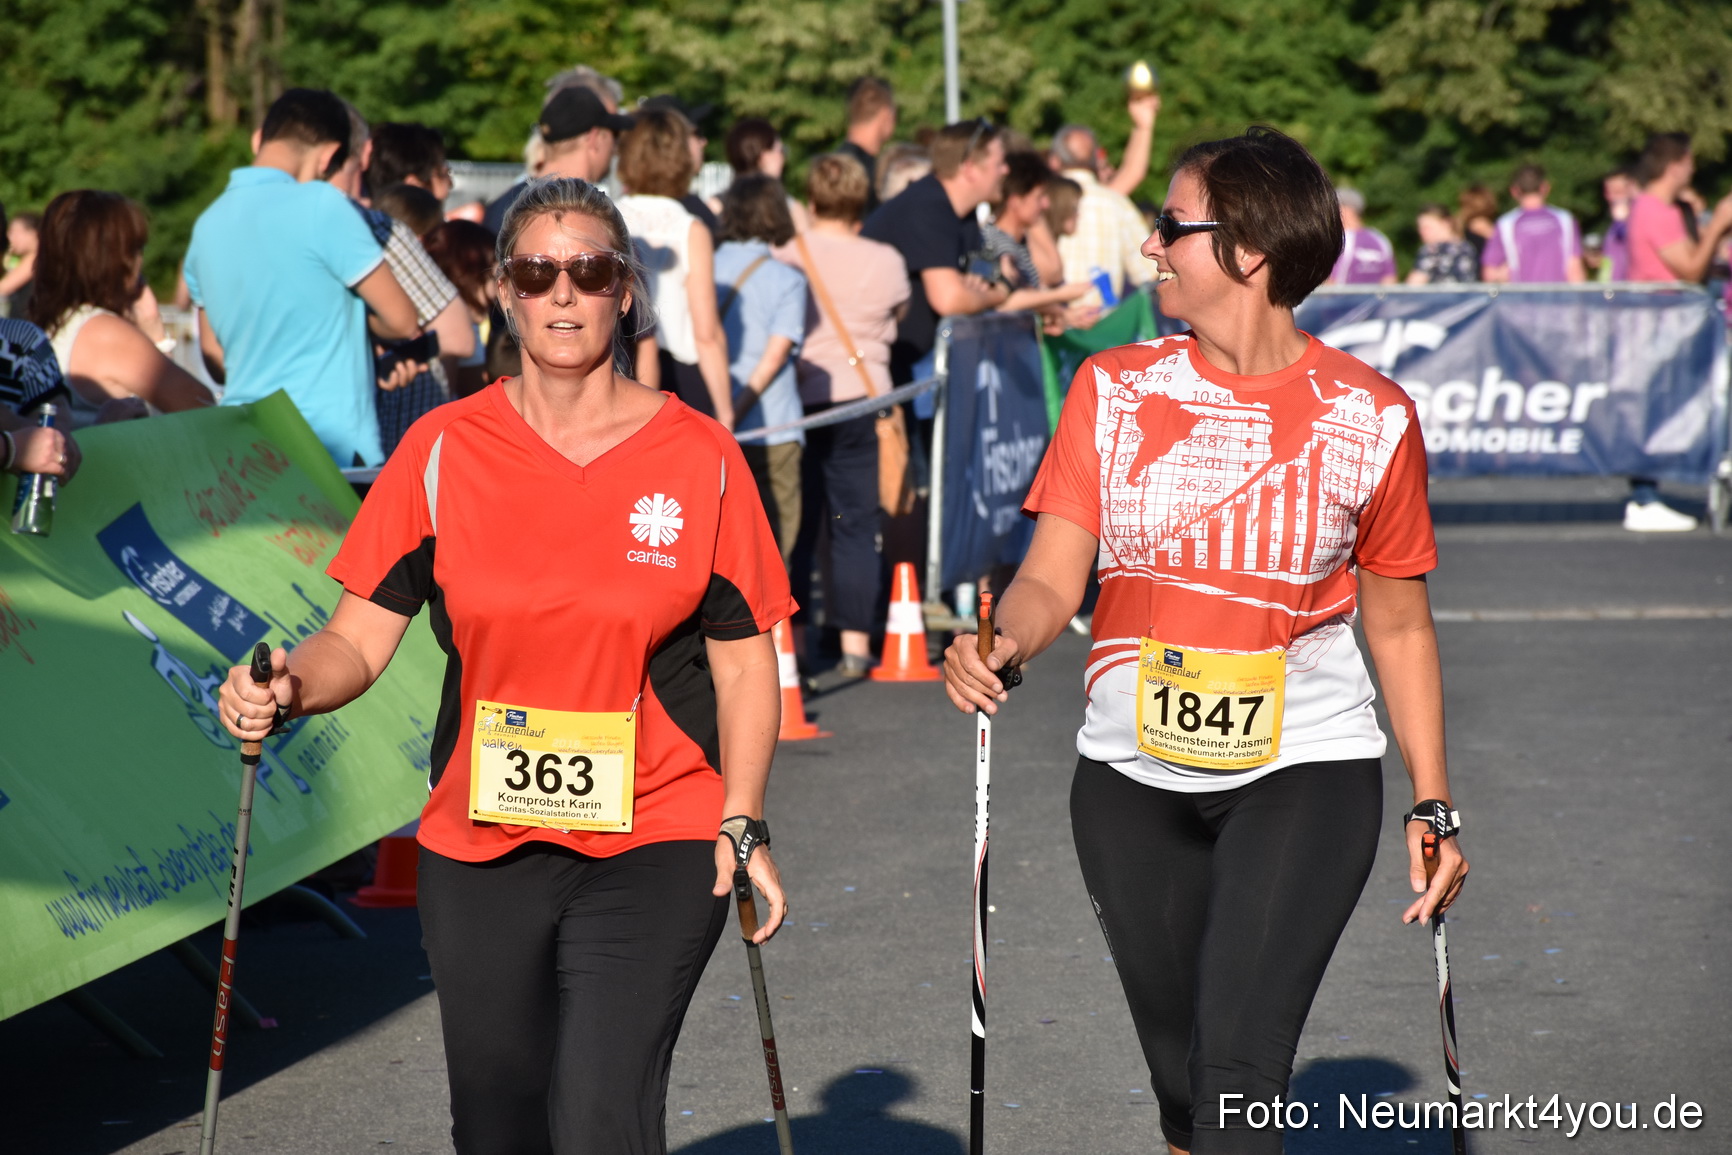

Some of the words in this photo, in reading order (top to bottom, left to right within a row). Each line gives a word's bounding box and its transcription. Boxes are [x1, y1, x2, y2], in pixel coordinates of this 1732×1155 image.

[1192, 390, 1231, 405] 10.54
[1406, 366, 1608, 423] scher
[1330, 407, 1381, 430] 91.62%
[1183, 434, 1228, 448] 24.87
[1425, 427, 1584, 454] OMOBILE
[1180, 455, 1224, 470] 52.01
[1176, 477, 1222, 493] 26.22
[626, 549, 677, 569] caritas
[1155, 660, 1201, 680] firmenlauf
[1153, 686, 1264, 736] 1847
[494, 721, 546, 738] firmenlauf
[1143, 723, 1230, 749] Kerschensteiner
[1233, 736, 1273, 749] Jasmin
[1150, 737, 1186, 753] Sparkasse
[1187, 747, 1262, 759] Neumarkt-Parsberg
[504, 749, 594, 797] 363
[498, 792, 565, 808] Kornprobst
[569, 798, 602, 810] Karin
[498, 804, 581, 818] Caritas-Sozialstation
[583, 811, 599, 819] e.V.
[1436, 802, 1446, 833] LEKI
[739, 833, 753, 860] LEKI
